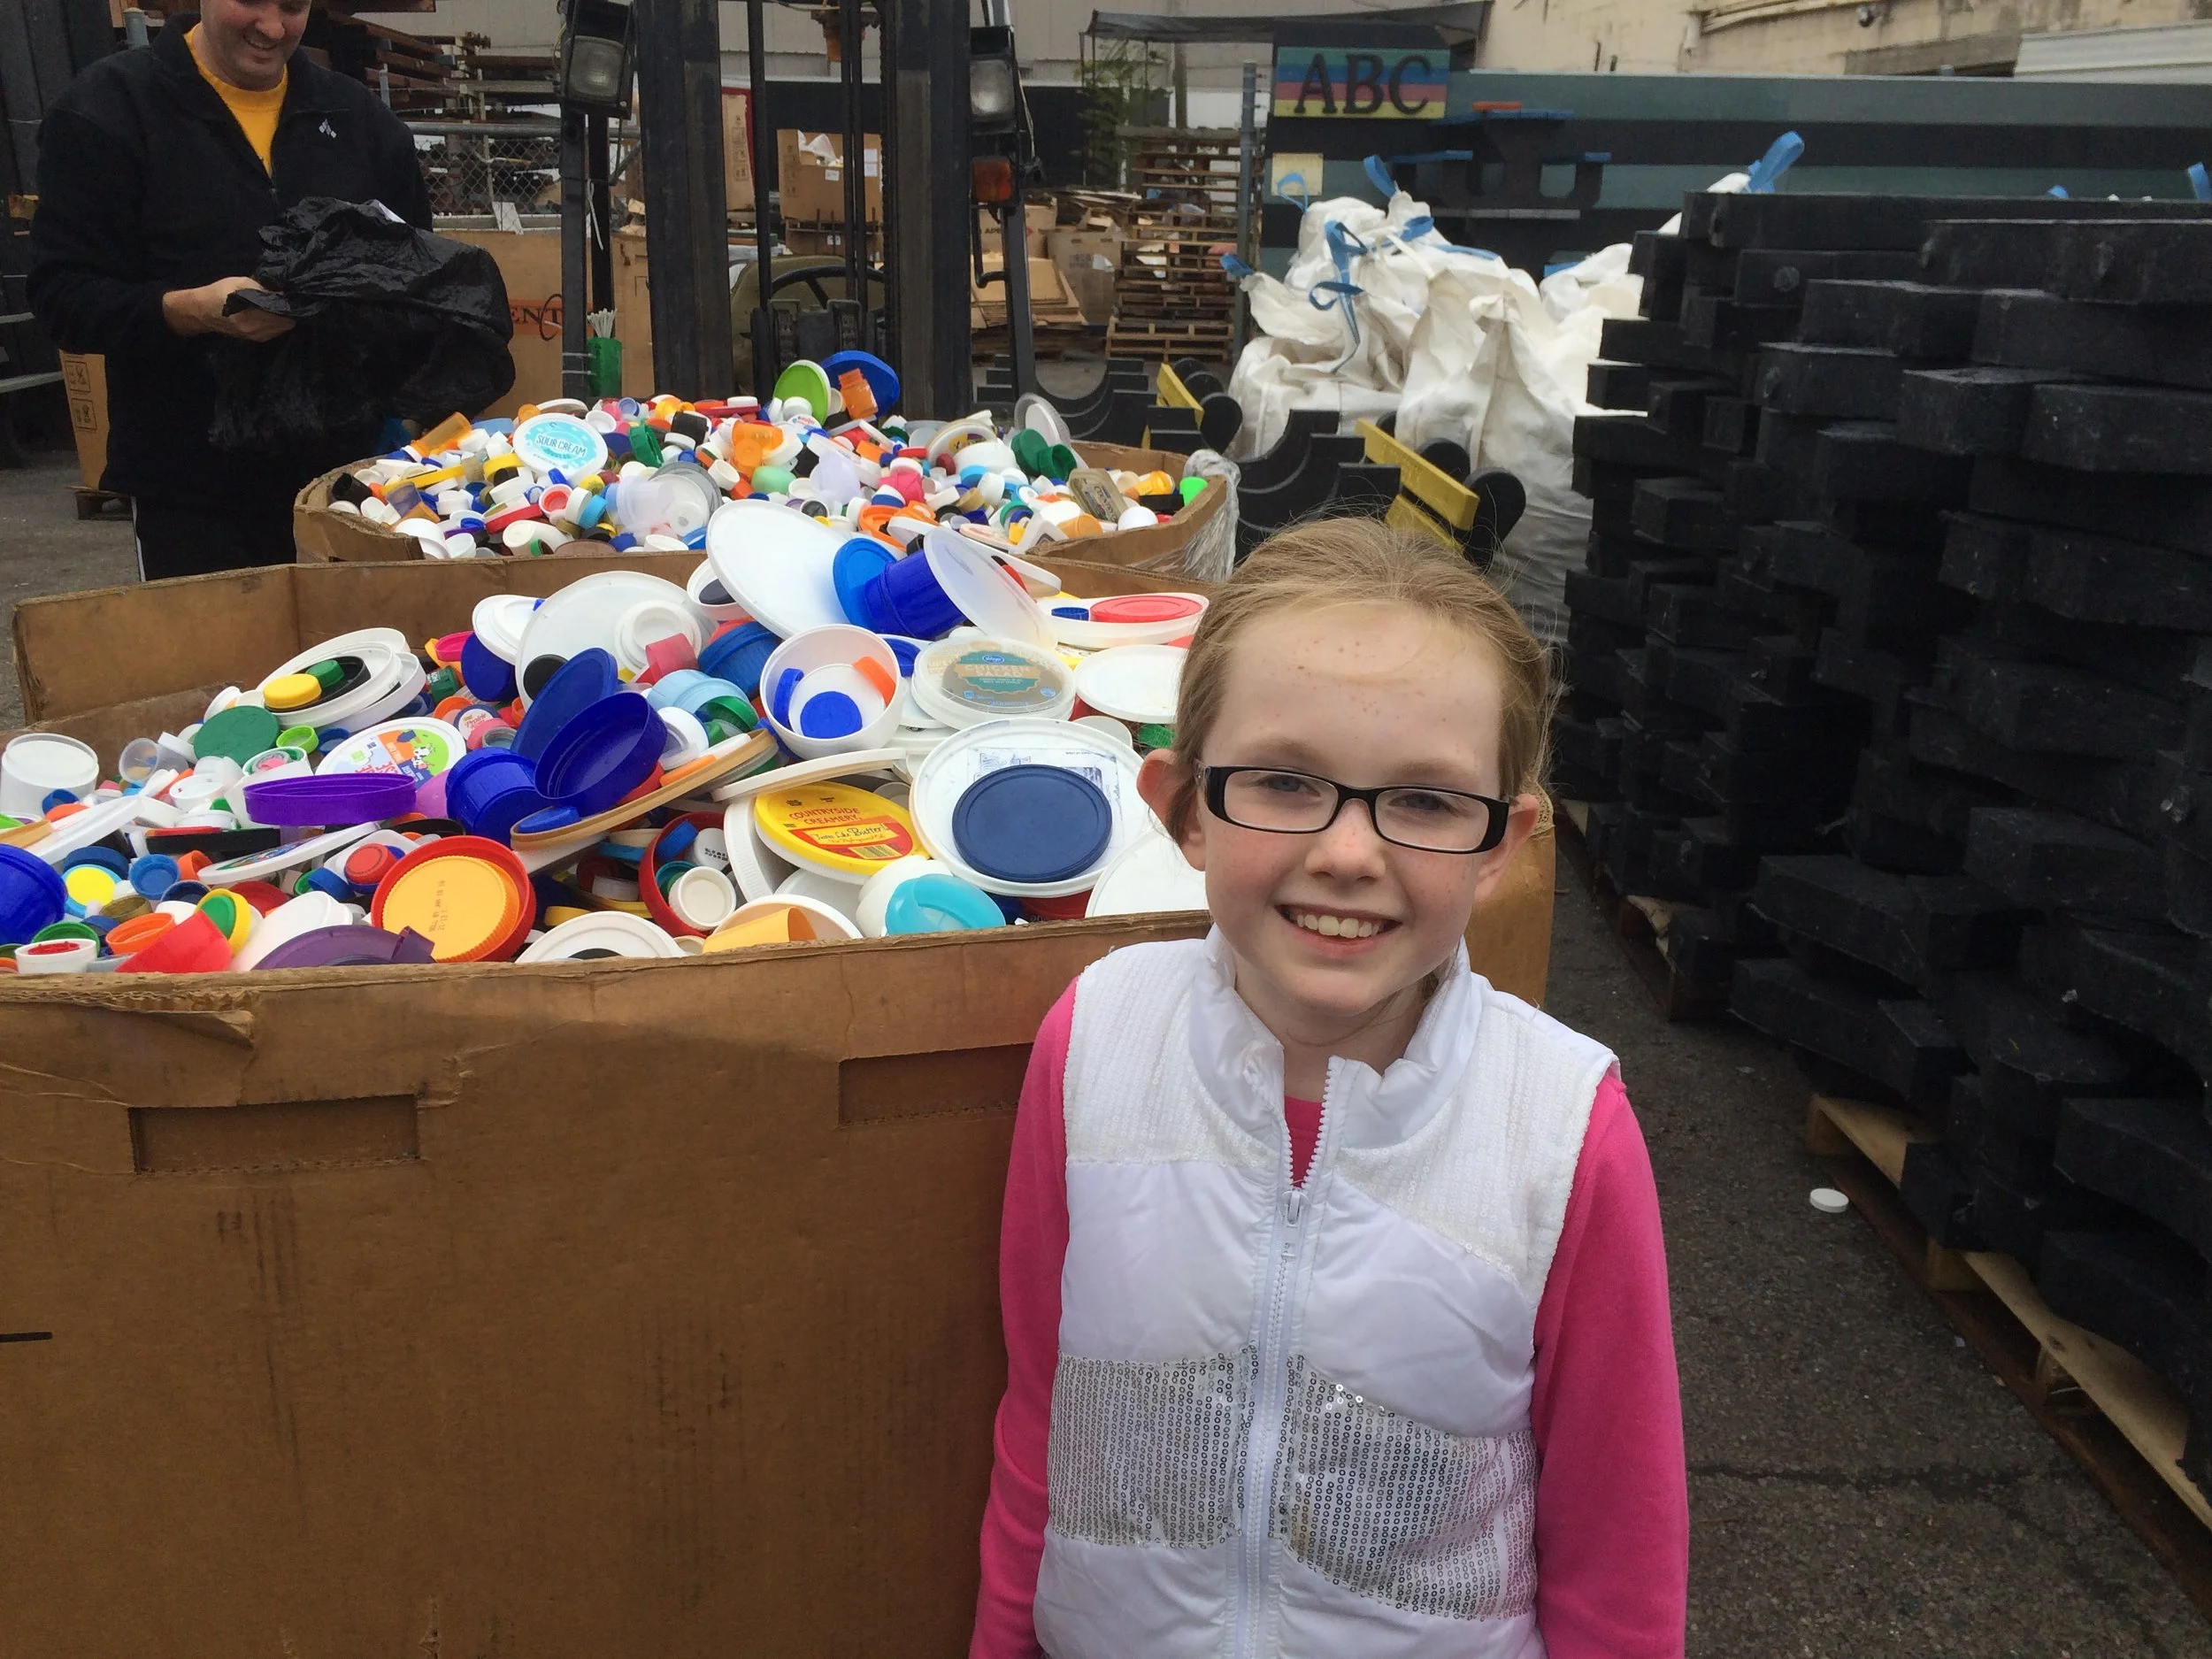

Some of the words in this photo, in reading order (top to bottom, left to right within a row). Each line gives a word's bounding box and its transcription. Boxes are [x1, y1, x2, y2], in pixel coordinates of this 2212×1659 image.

[1294, 53, 1431, 115] ABC
[536, 434, 558, 449] SOUR
[557, 441, 587, 457] CREAM
[788, 807, 861, 819] COUNTRYSIDE
